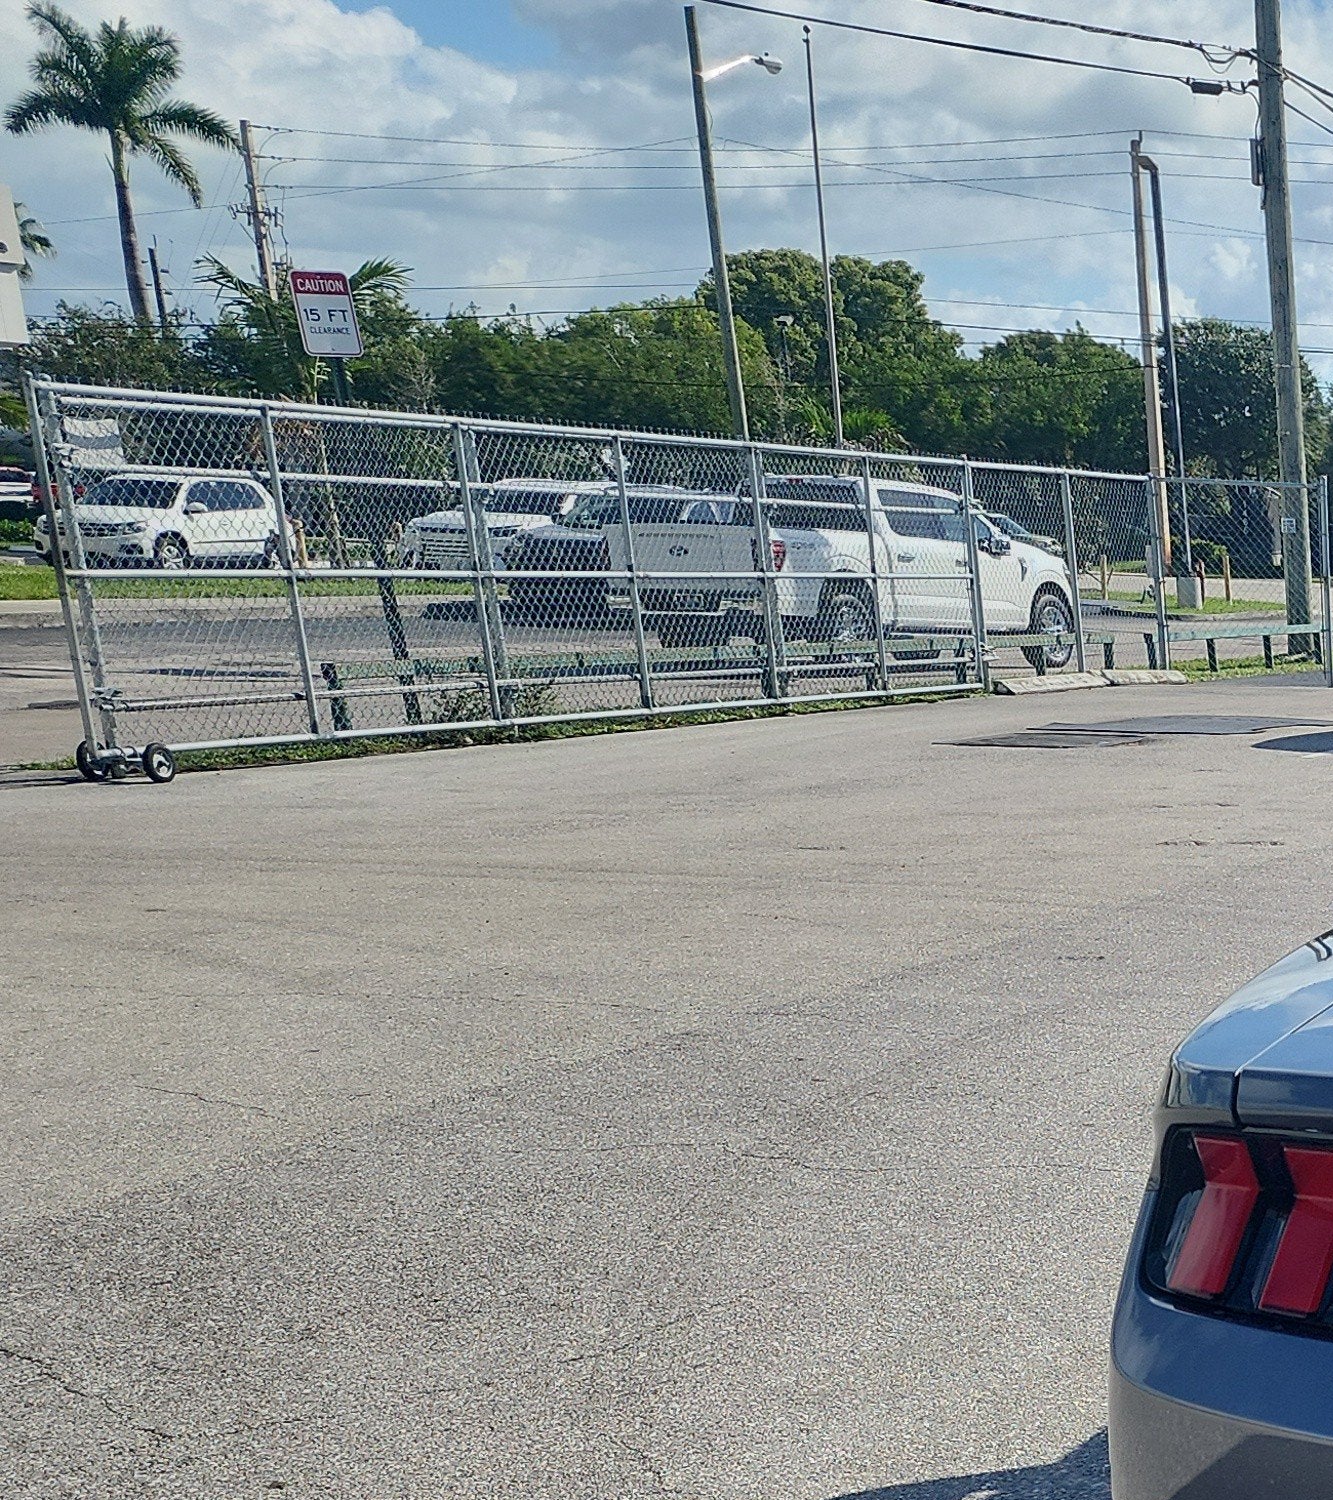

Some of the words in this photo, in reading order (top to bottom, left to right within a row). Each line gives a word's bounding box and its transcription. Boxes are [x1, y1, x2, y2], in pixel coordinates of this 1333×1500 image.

[297, 278, 345, 292] CAUTION
[303, 308, 322, 322] 15
[327, 308, 349, 322] FT
[310, 326, 351, 335] CLEARANCE
